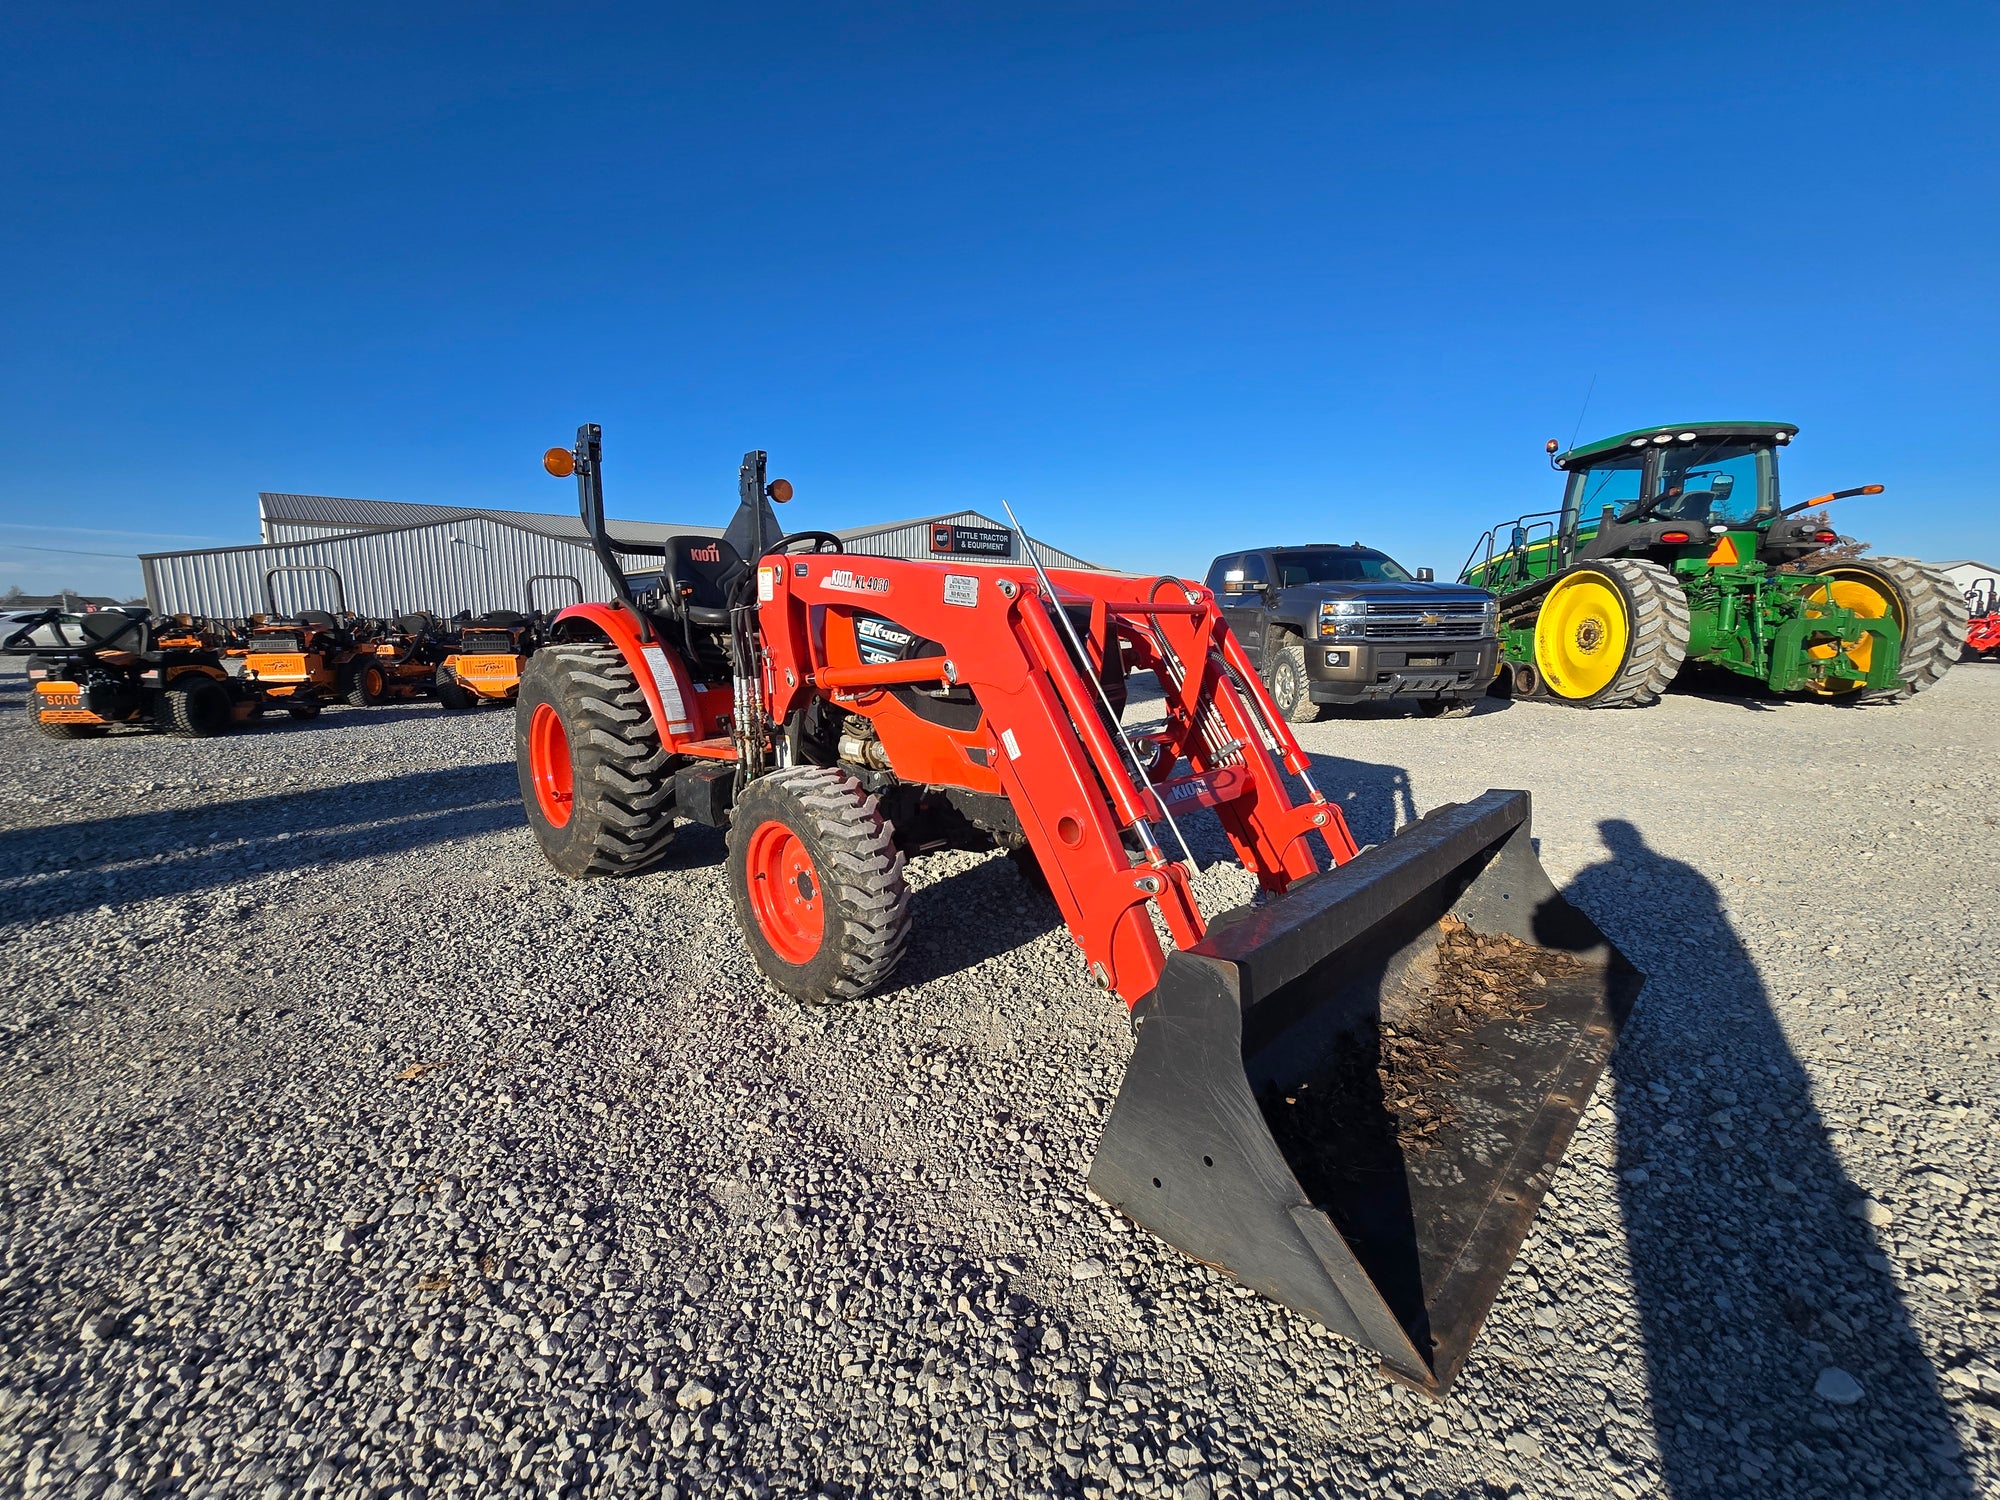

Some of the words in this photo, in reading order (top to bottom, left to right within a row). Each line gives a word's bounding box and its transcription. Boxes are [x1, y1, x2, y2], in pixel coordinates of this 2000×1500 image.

[956, 531, 978, 540] LITTLE
[980, 533, 1009, 542] TRACTOR
[967, 542, 1004, 550] EQUIPMENT
[690, 548, 720, 562] KIOTI
[831, 569, 853, 588] KIOTI
[854, 575, 865, 589] KL
[46, 695, 79, 705] SCAG
